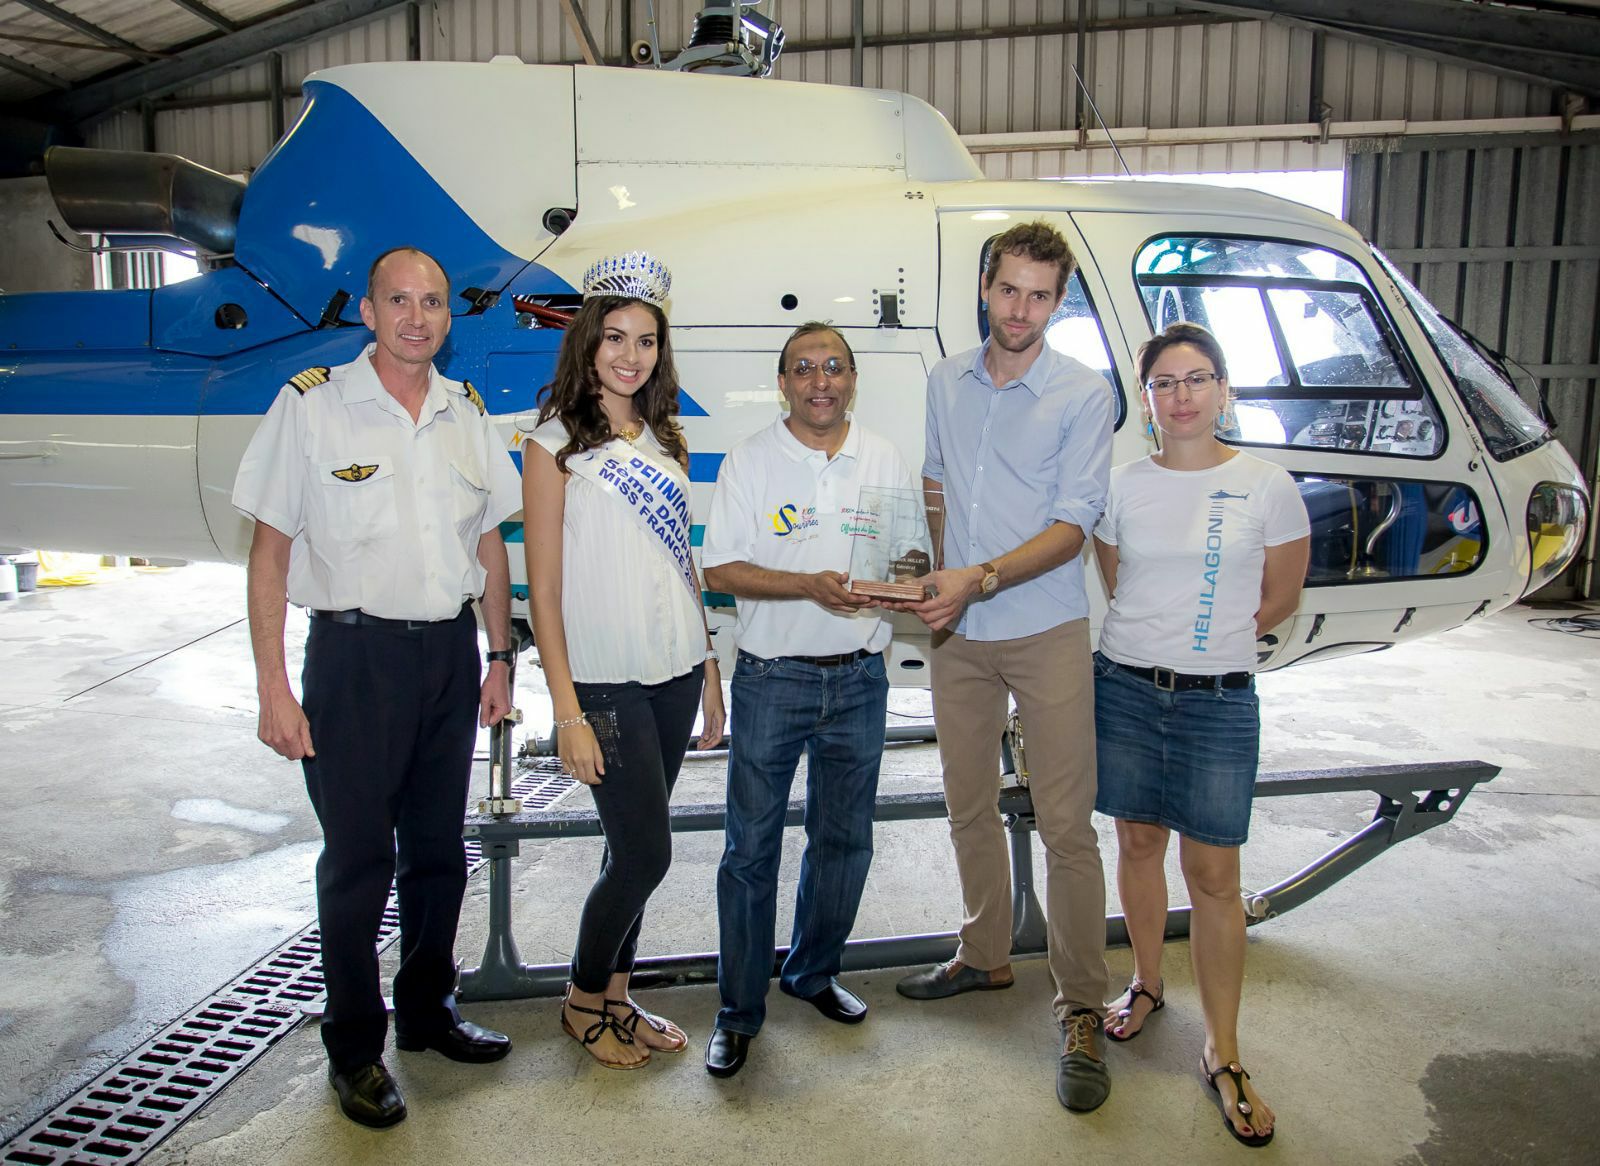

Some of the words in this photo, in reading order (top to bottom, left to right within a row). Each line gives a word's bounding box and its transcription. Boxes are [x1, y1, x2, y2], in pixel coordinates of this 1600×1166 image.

[598, 467, 639, 506] MISS
[639, 505, 685, 568] FRANCE
[604, 458, 654, 504] 5ème
[1192, 517, 1224, 652] HELILAGON
